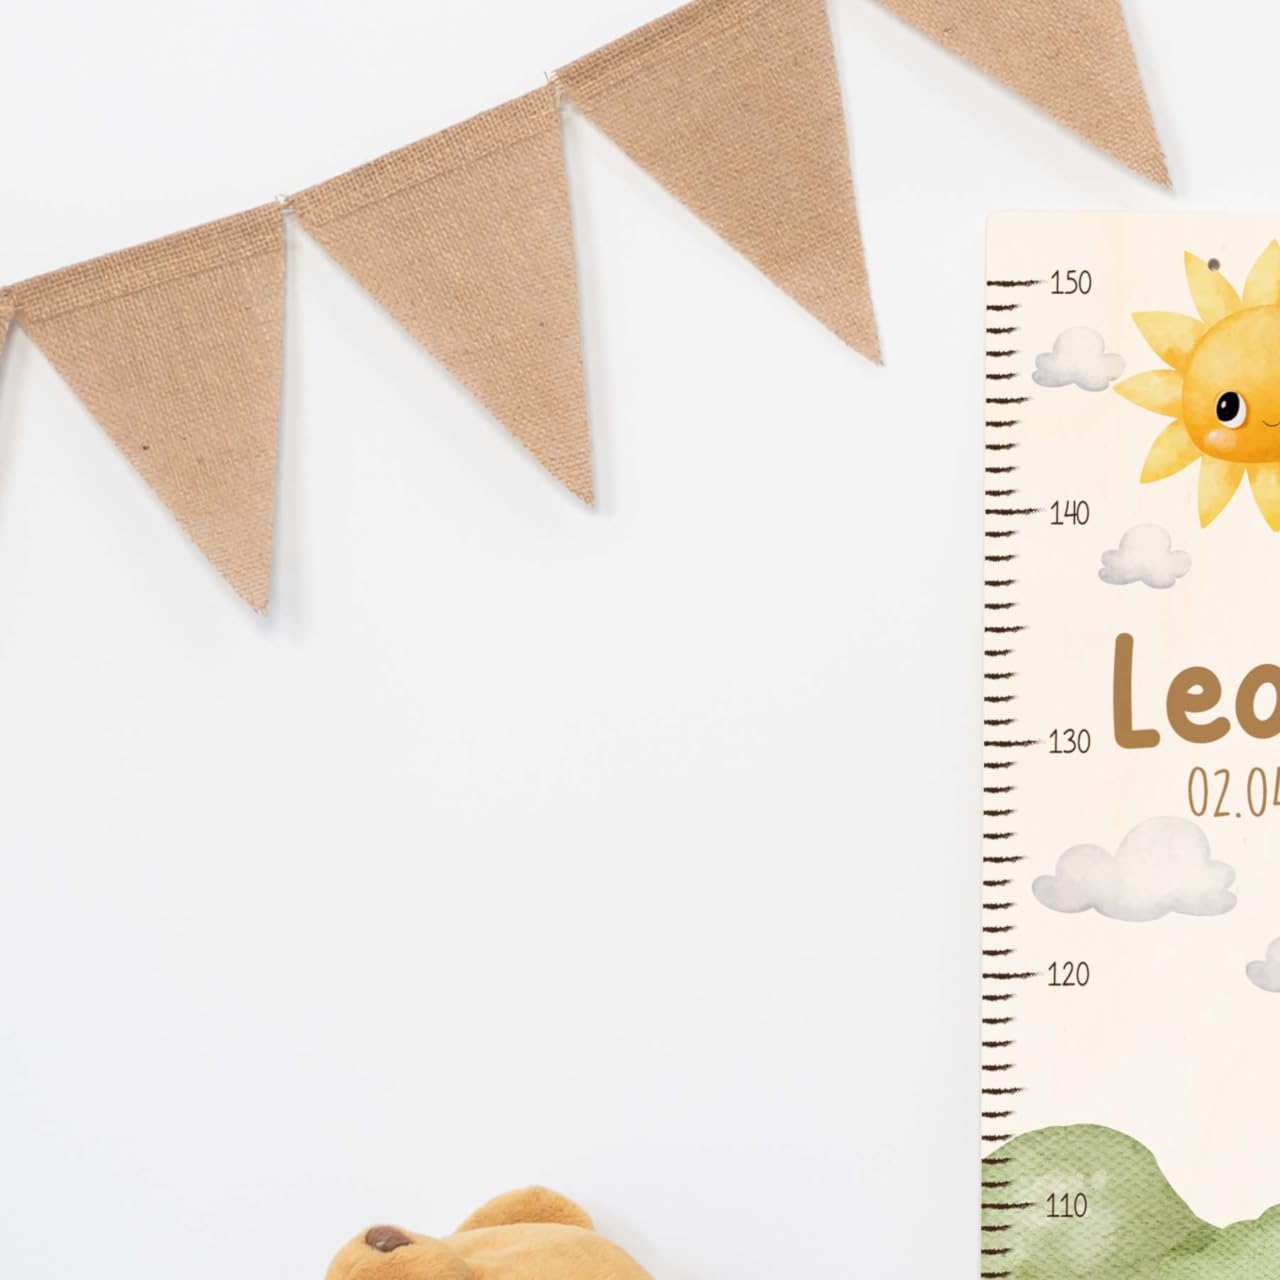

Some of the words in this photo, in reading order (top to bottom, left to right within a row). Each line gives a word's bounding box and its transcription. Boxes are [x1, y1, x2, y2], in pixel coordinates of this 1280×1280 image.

[1051, 269, 1092, 295] 150
[1050, 500, 1090, 525] 140
[1049, 728, 1091, 754] 130
[1048, 961, 1090, 986] 120
[1046, 1192, 1087, 1218] 110
